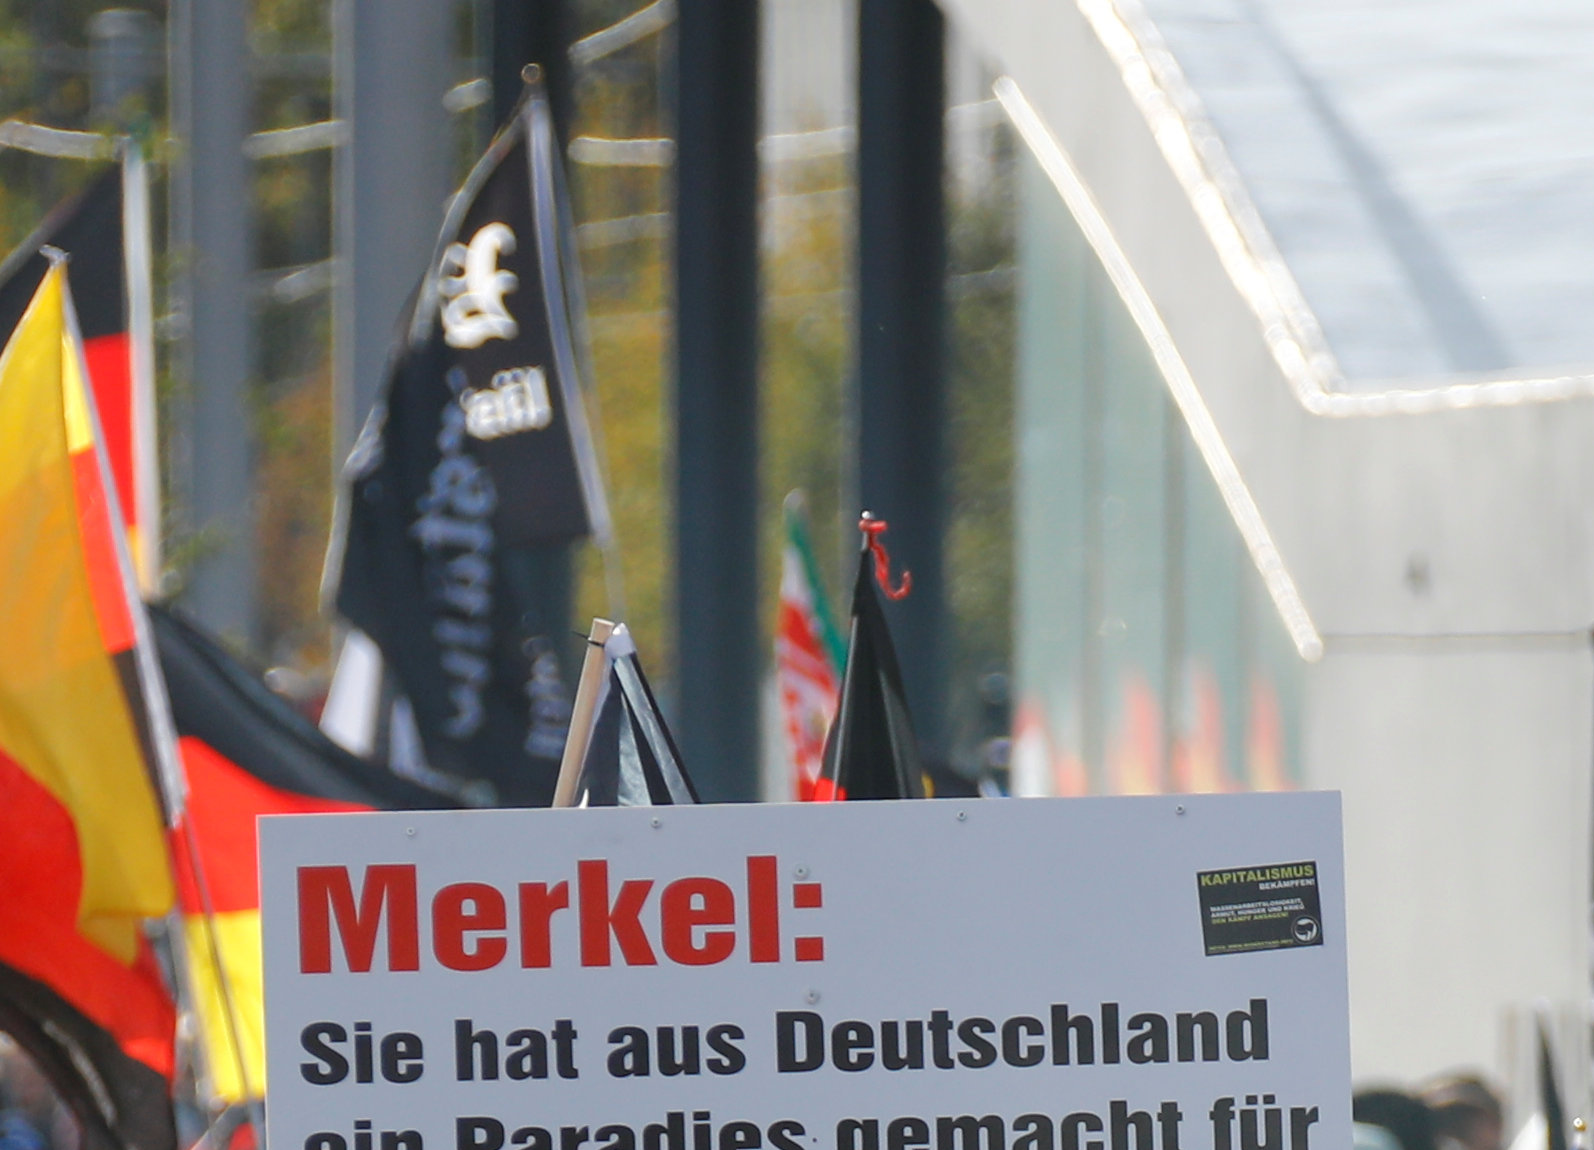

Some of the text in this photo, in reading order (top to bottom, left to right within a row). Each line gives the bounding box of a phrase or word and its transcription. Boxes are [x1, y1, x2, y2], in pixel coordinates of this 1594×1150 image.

[297, 856, 824, 974] Merkel:
[1201, 865, 1314, 886] KAPITALISMUS
[301, 999, 1269, 1085] Sie hat aus Deutschland
